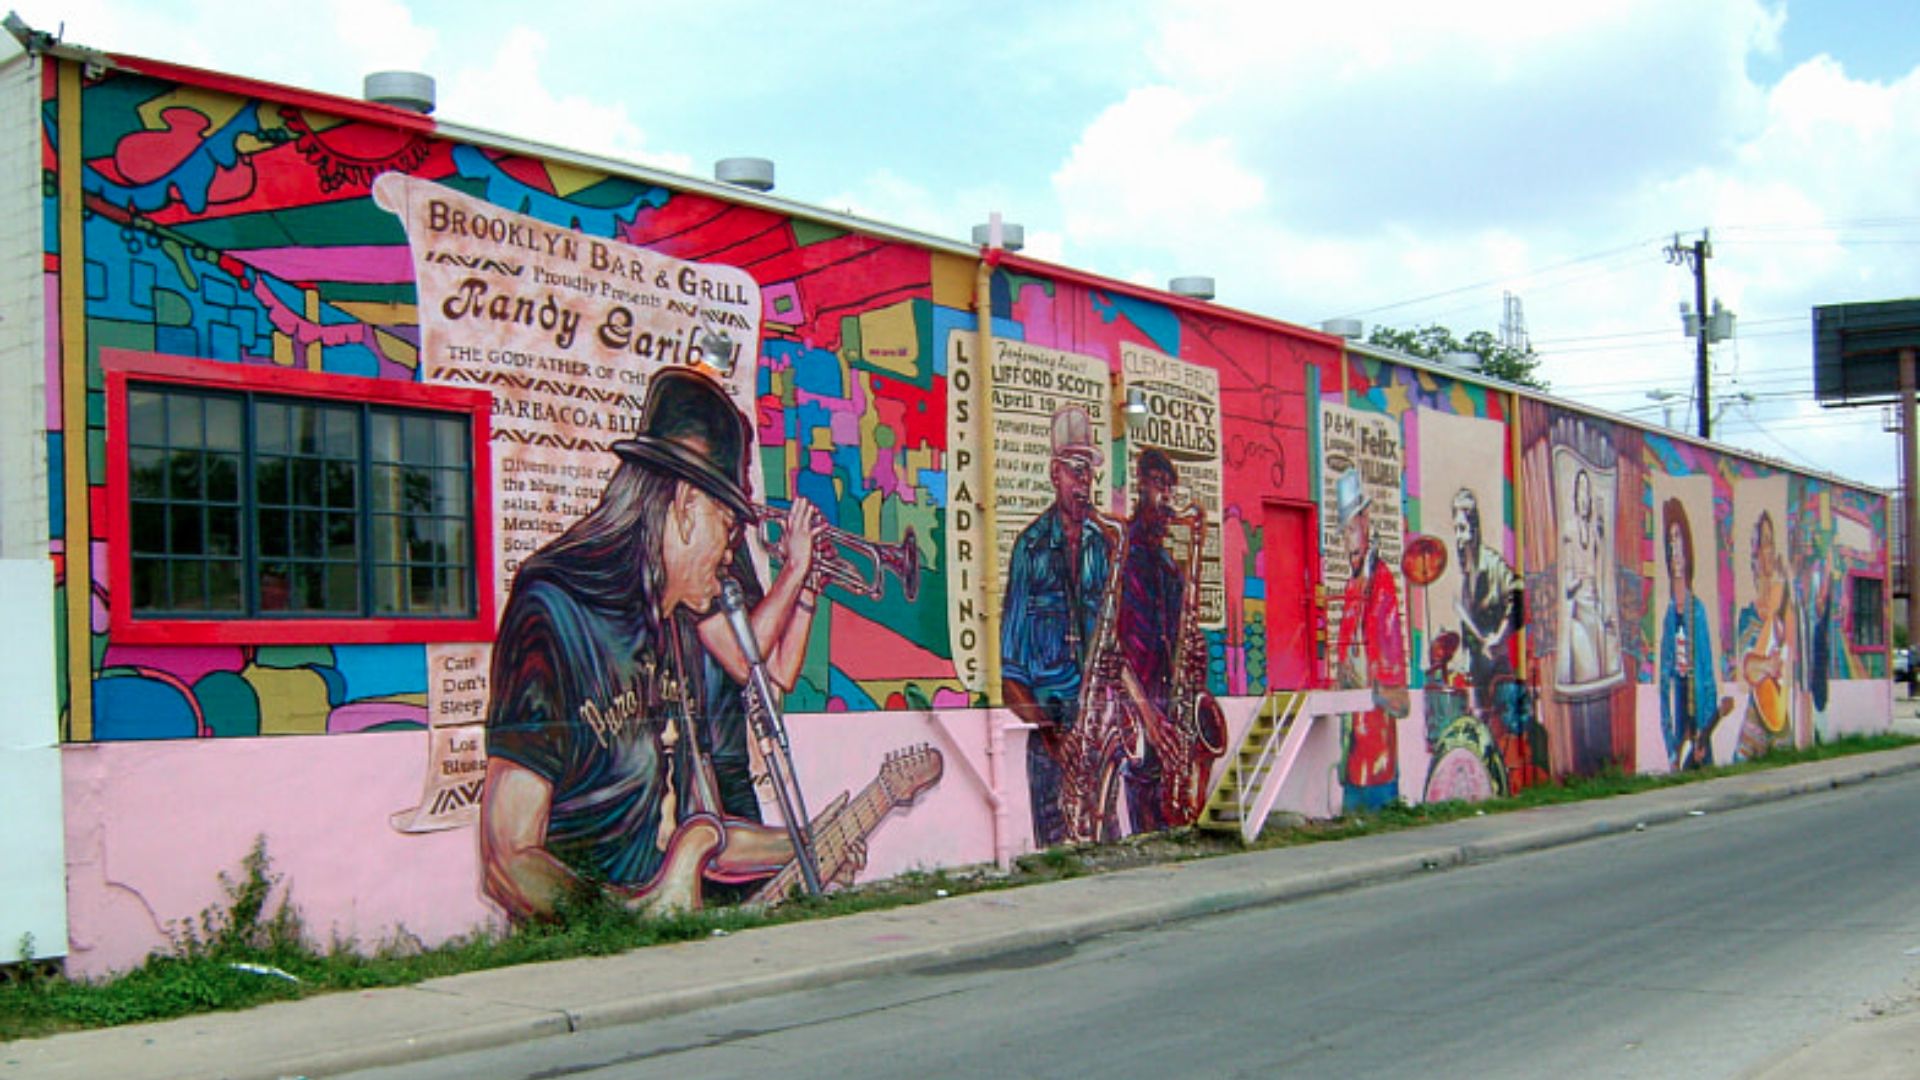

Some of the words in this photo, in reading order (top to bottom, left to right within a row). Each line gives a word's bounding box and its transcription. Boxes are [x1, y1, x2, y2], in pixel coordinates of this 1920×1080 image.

[428, 200, 579, 262] BROOKLYN
[589, 241, 645, 284] BAR
[655, 270, 669, 290] &
[677, 266, 749, 306] GRILL
[532, 264, 597, 297] Proudly
[442, 277, 581, 350] Randy
[597, 306, 742, 379] Gariby
[447, 345, 482, 363] THE
[595, 364, 615, 379] OF
[1057, 372, 1104, 399] SCOTT
[503, 479, 526, 492] the
